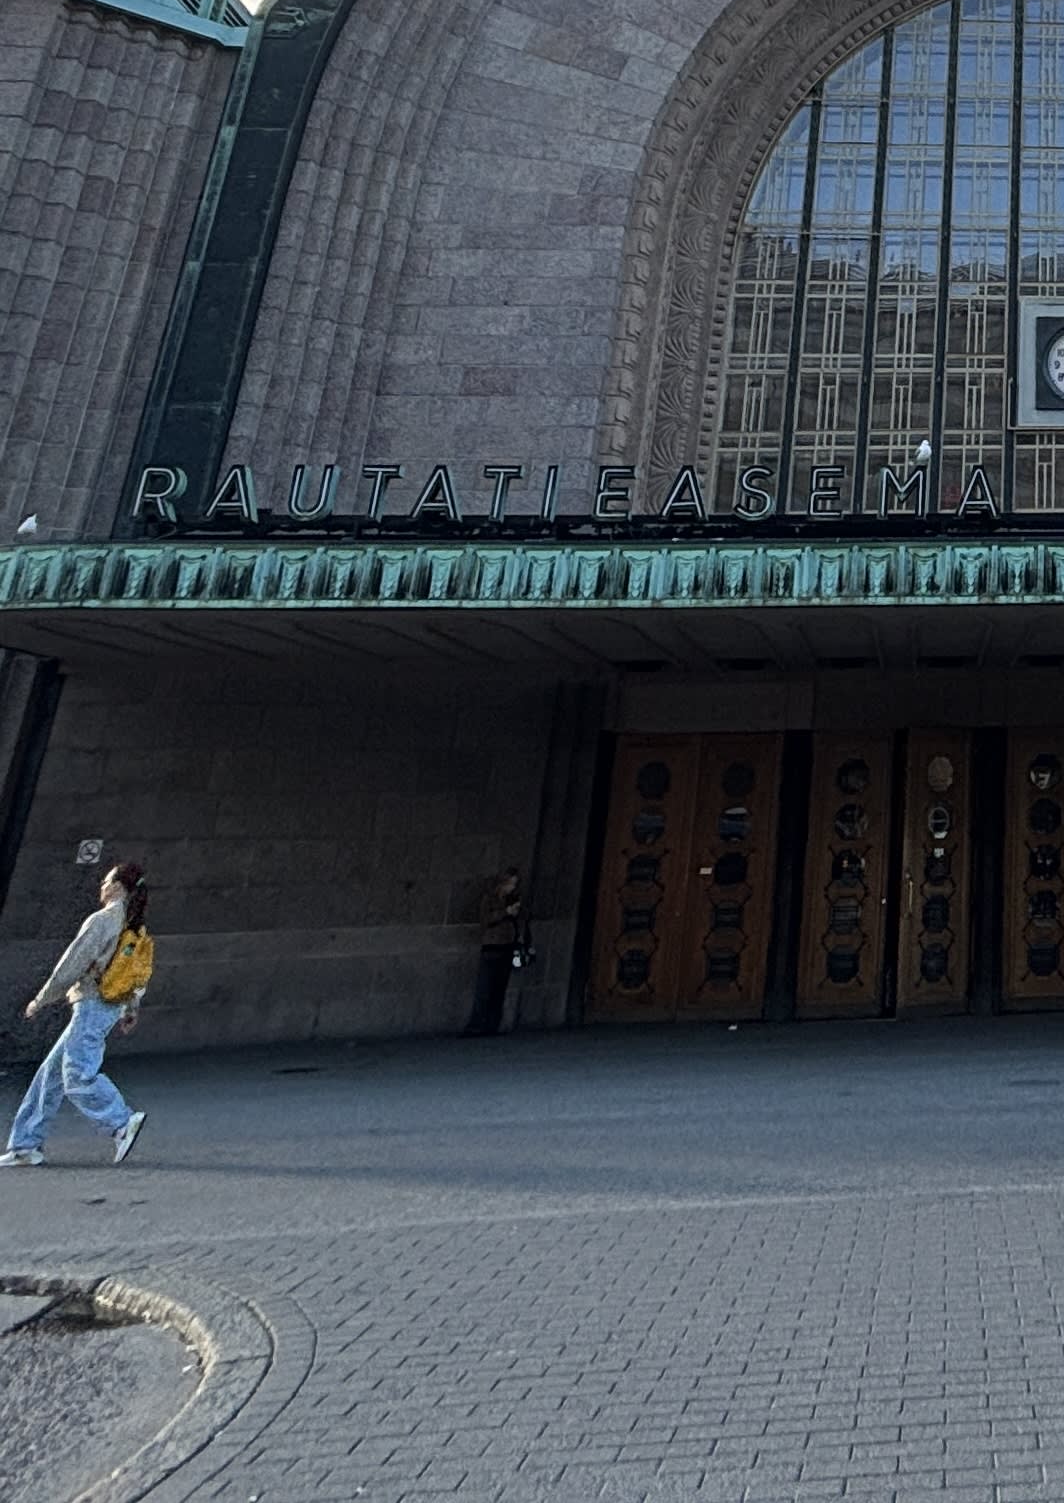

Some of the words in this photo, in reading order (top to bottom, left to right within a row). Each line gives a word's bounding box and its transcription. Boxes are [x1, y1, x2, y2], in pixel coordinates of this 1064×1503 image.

[1057, 349, 1064, 357] 10
[1054, 361, 1060, 369] 9
[131, 463, 1000, 524] RAUTATIEASEMA
